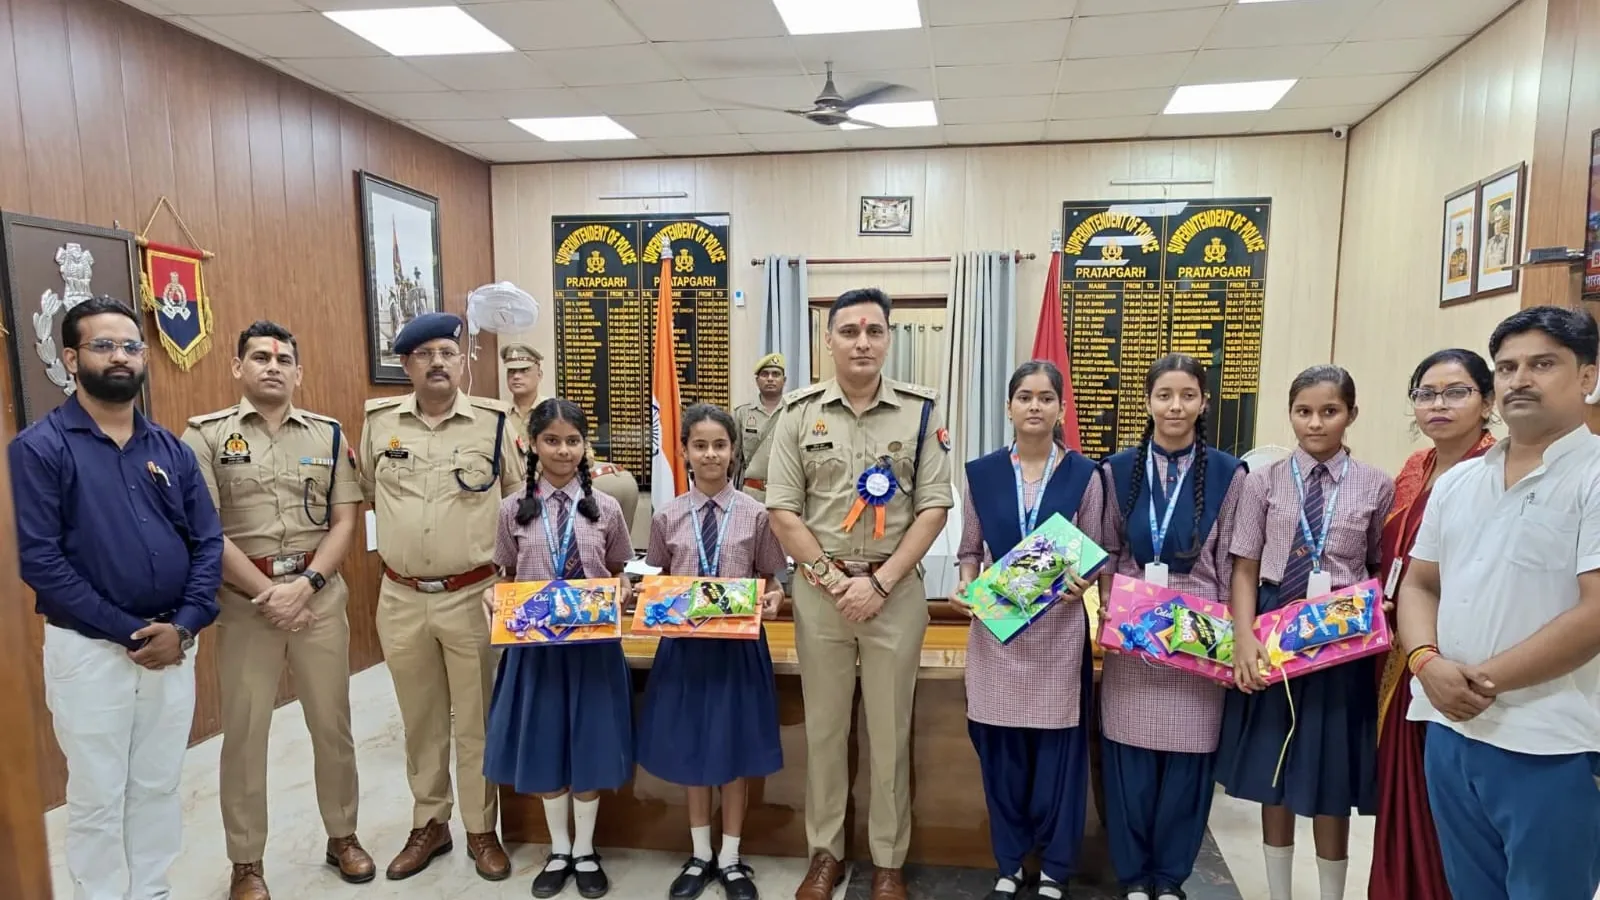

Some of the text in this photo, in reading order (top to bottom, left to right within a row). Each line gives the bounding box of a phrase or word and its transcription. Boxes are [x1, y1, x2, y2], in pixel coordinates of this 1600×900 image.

[1064, 211, 1160, 255] SUPERINTENDENT OF POLICE
[1167, 209, 1266, 254] SUPERINTENDENT OF POLICE
[555, 224, 638, 265] SUPERINTENDENT OF POLICE
[697, 226, 709, 243] OF
[703, 232, 727, 264] POLICE
[1076, 266, 1146, 279] PRATAPGARH
[1178, 265, 1251, 279] PRATAPGARH
[566, 276, 627, 288] PRATAPGARH
[654, 276, 716, 287] PTAPGARH
[1088, 282, 1107, 290] NAME
[1191, 281, 1210, 289] NAME
